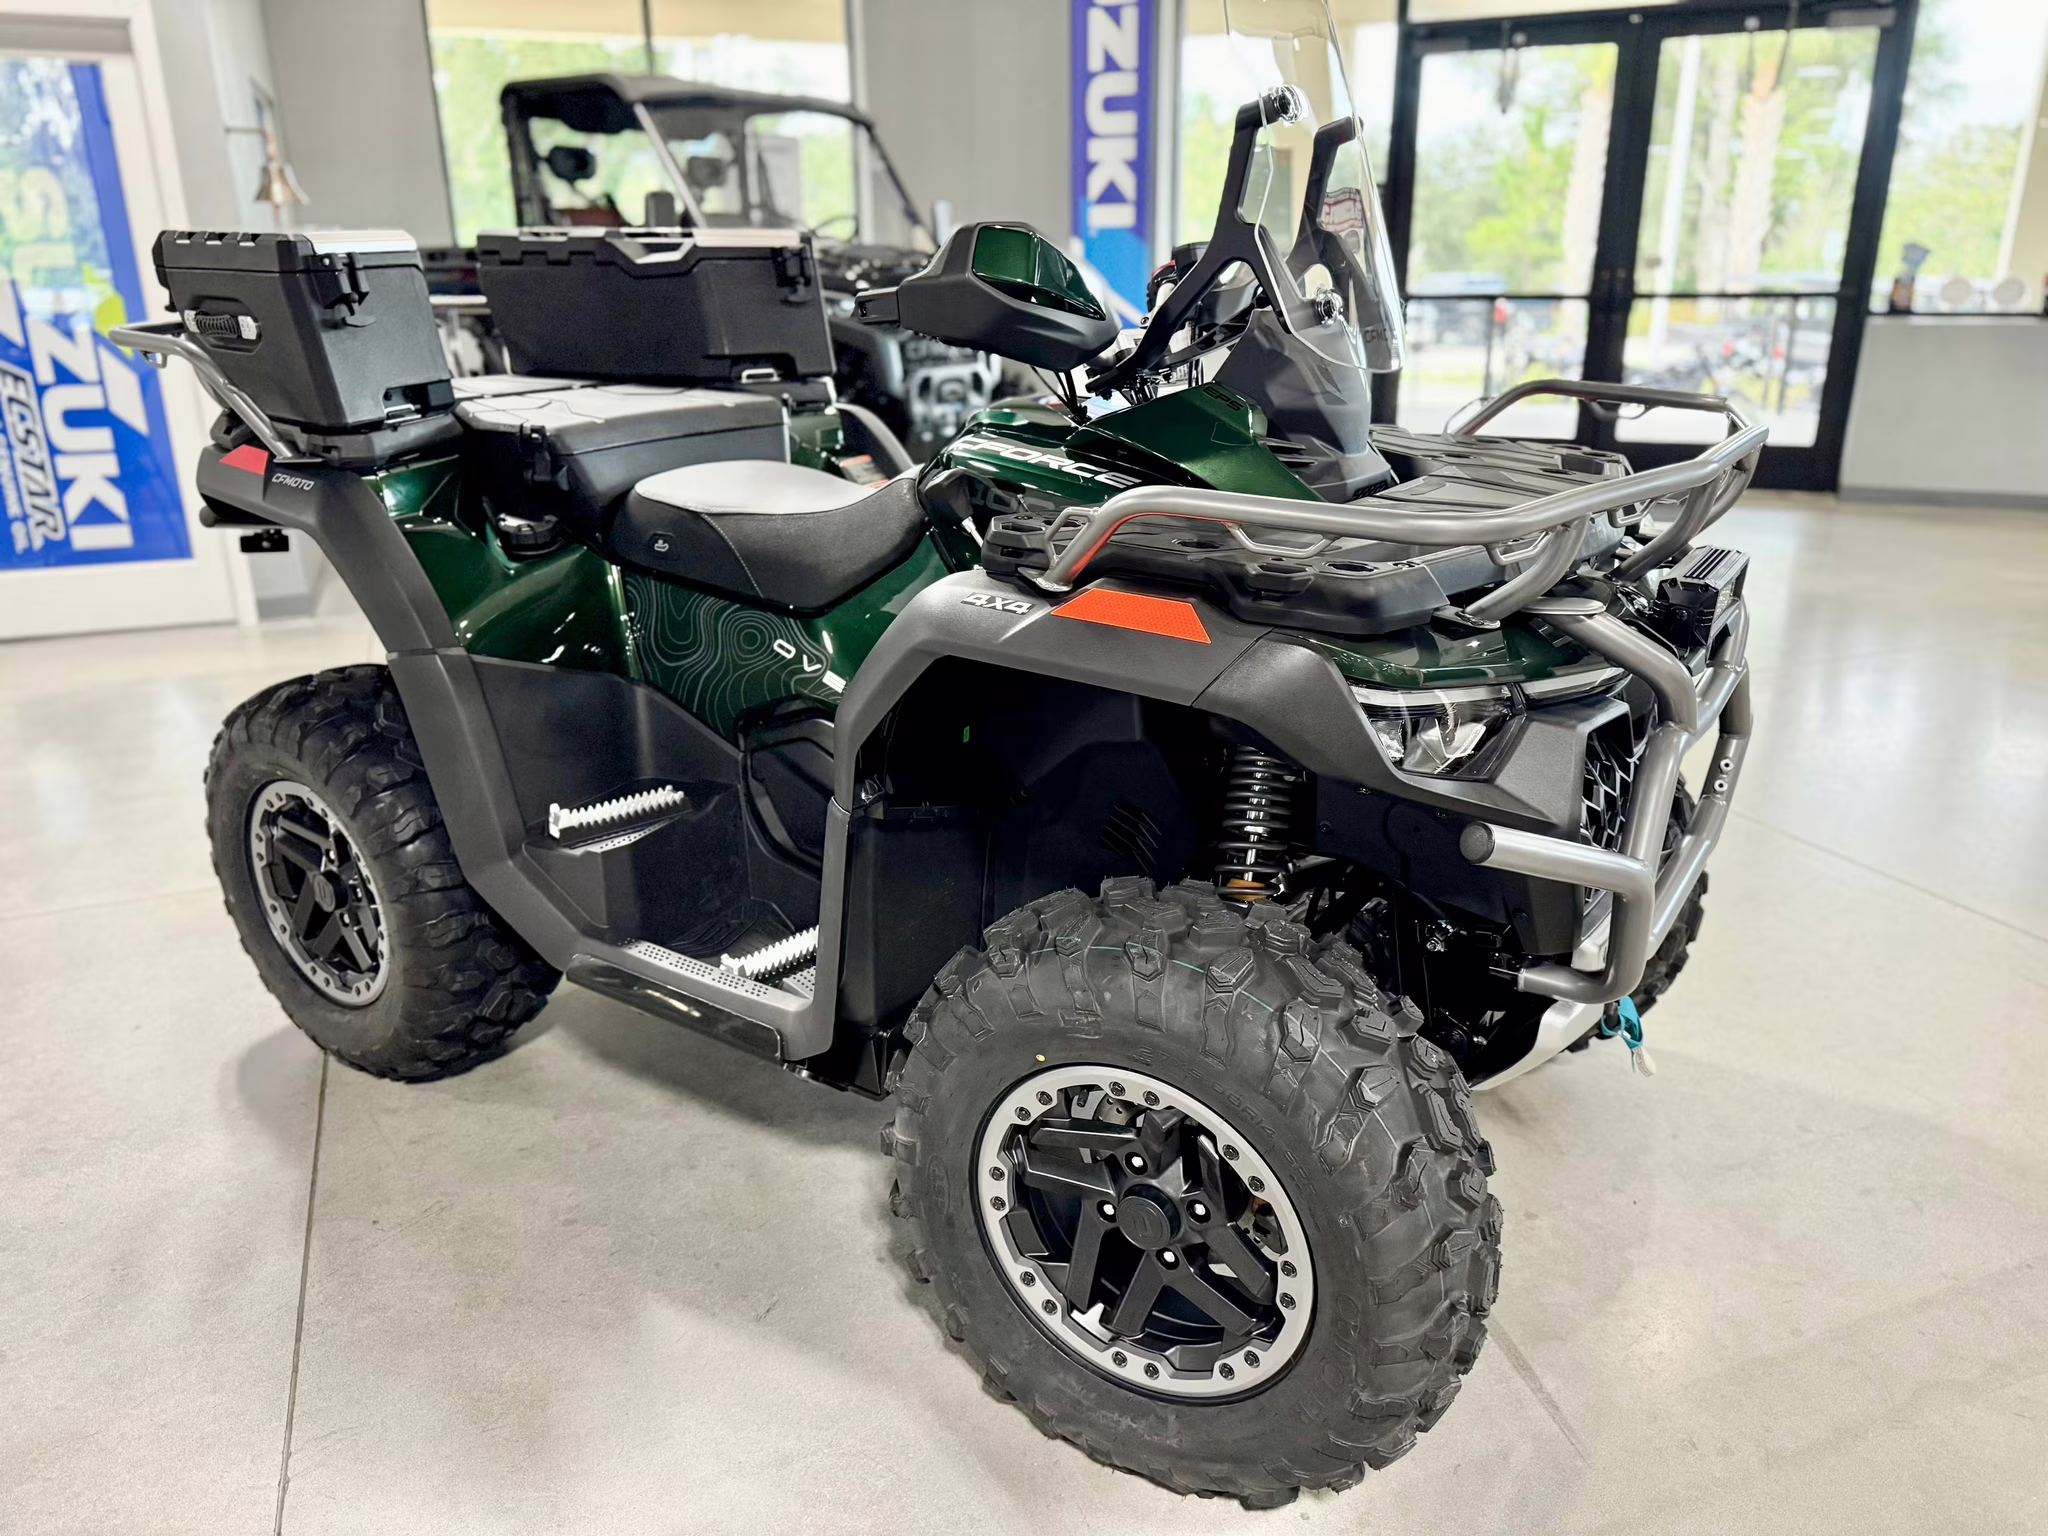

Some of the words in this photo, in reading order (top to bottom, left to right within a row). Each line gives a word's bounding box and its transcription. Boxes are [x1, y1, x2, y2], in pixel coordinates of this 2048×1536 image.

[1085, 0, 1139, 228] ZUKI
[1202, 385, 1245, 412] EPS
[271, 472, 315, 491] CFMOTO
[951, 433, 1142, 489] CFORCE
